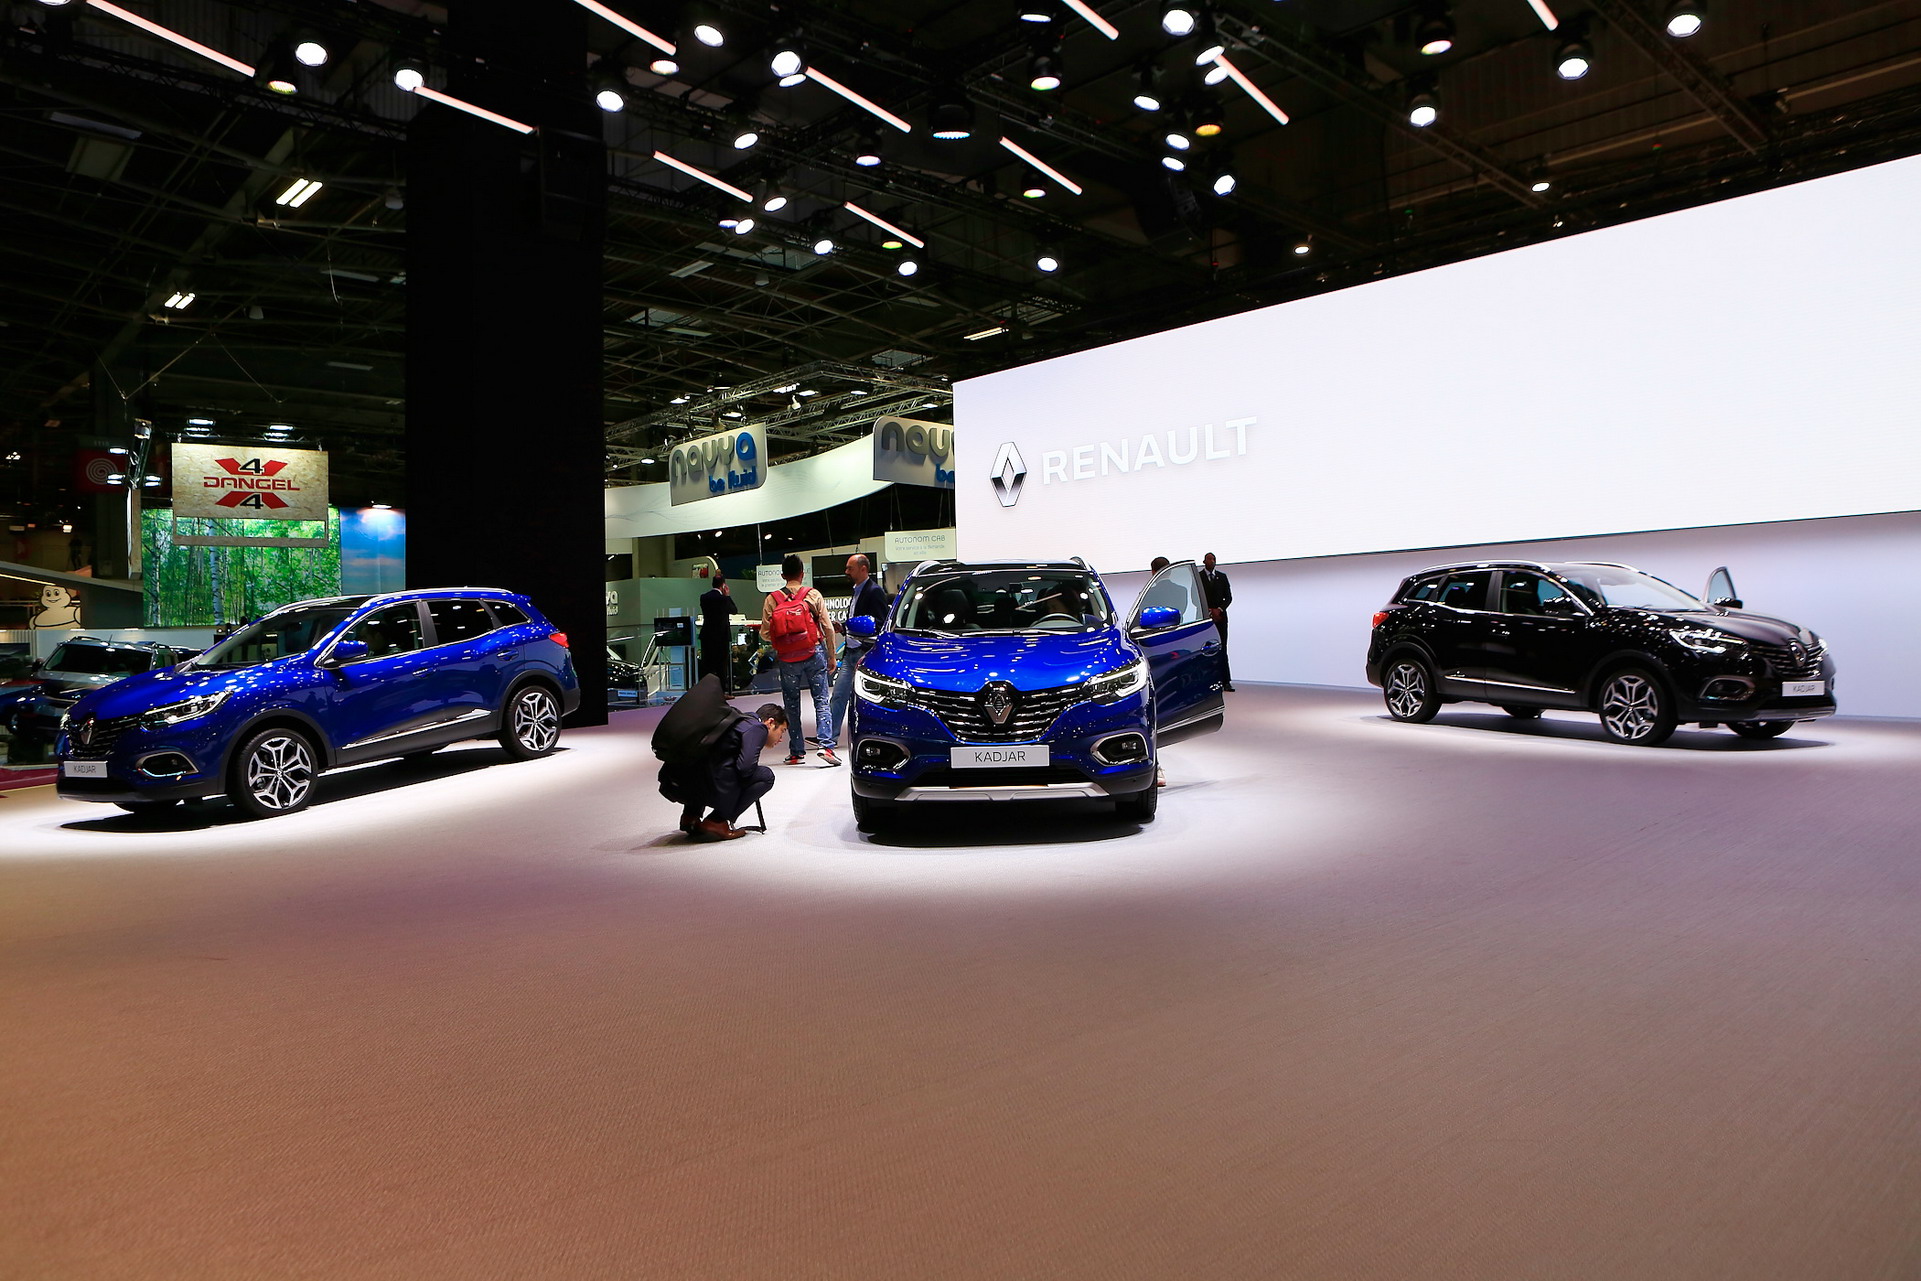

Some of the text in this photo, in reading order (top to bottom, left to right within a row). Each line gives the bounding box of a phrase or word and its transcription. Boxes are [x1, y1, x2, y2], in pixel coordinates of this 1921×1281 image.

[1042, 416, 1257, 484] RENAULT
[240, 458, 263, 474] 4
[203, 476, 300, 491] DANGEL
[709, 466, 757, 493] be fluid
[240, 494, 263, 509] 4
[895, 535, 929, 544] AUTONOM
[974, 750, 1026, 762] KADJAR
